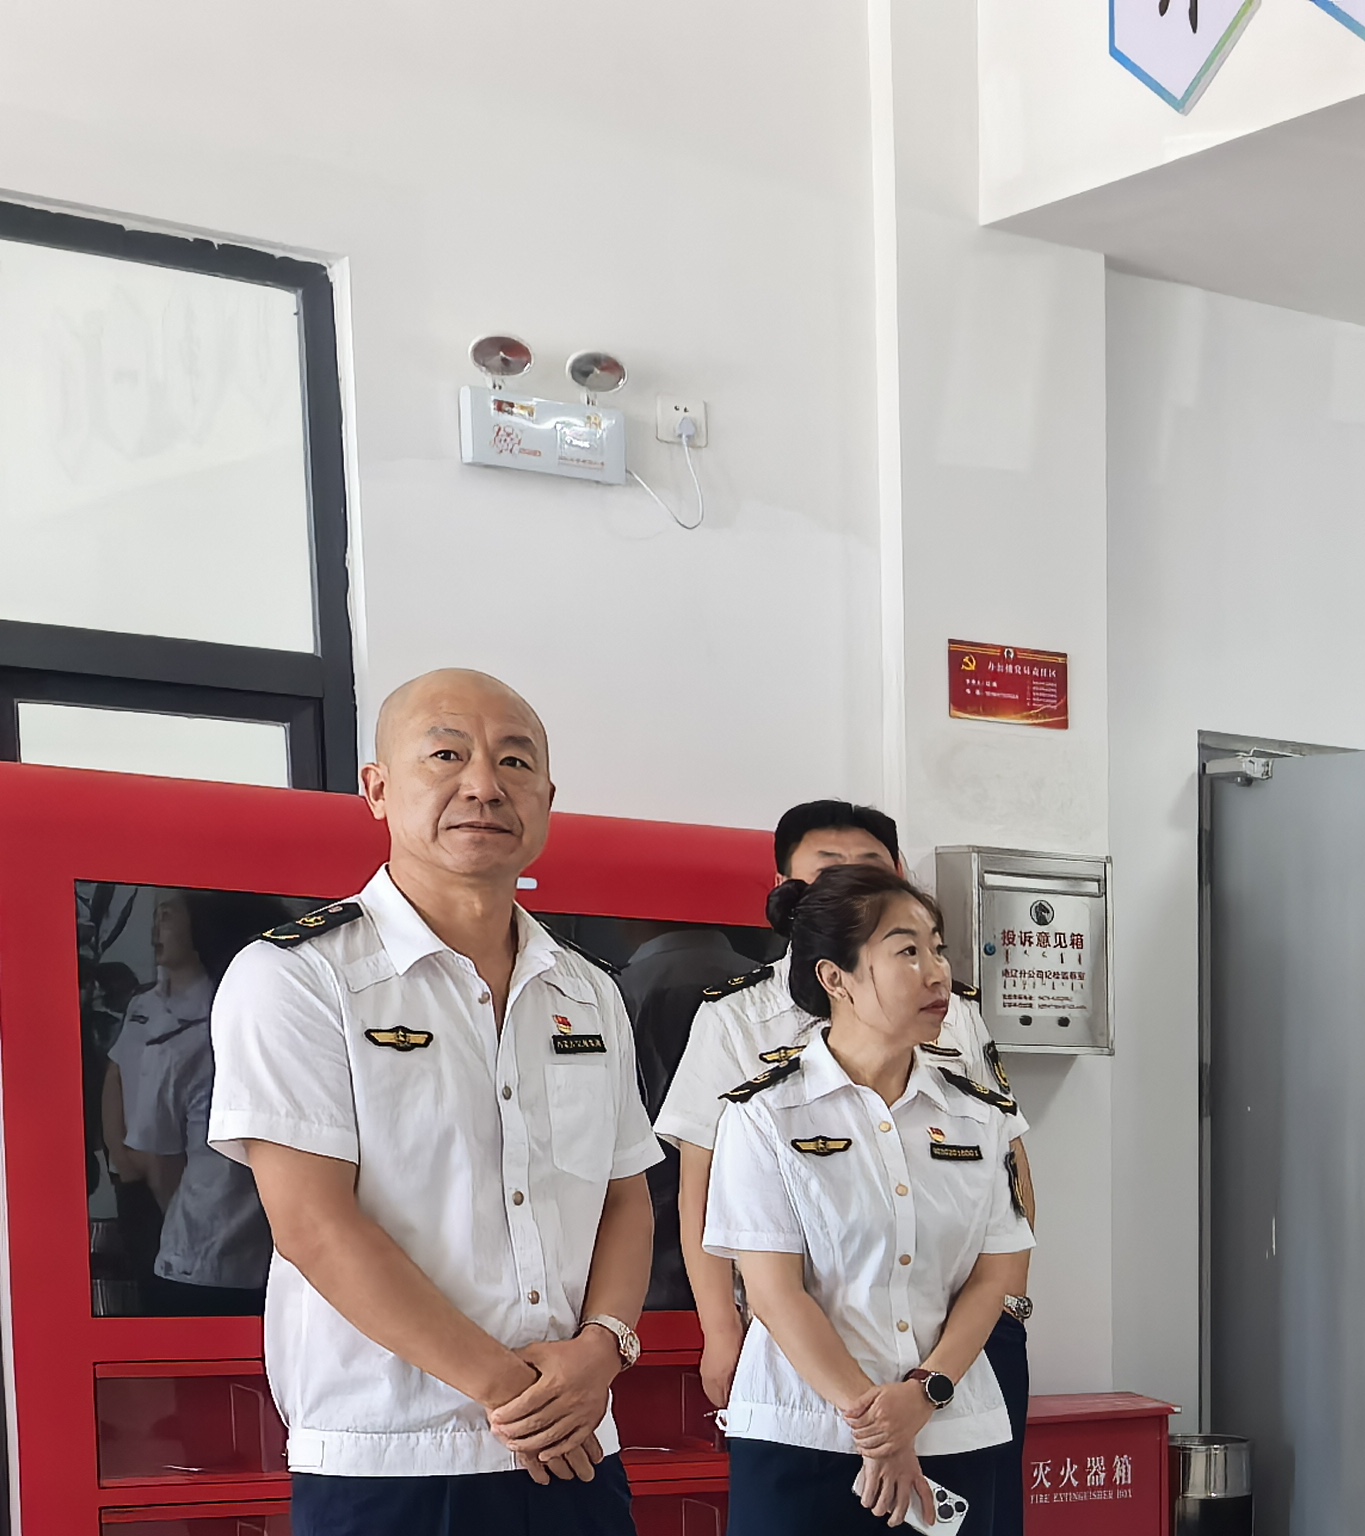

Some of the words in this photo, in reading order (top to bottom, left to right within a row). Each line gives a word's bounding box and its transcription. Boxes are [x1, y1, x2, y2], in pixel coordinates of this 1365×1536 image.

[1001, 929, 1084, 950] 投诉意见箱
[1030, 1455, 1132, 1489] 灭火器箱
[1030, 1493, 1050, 1504] FIRE
[1053, 1490, 1113, 1503] EXTINGUISHER
